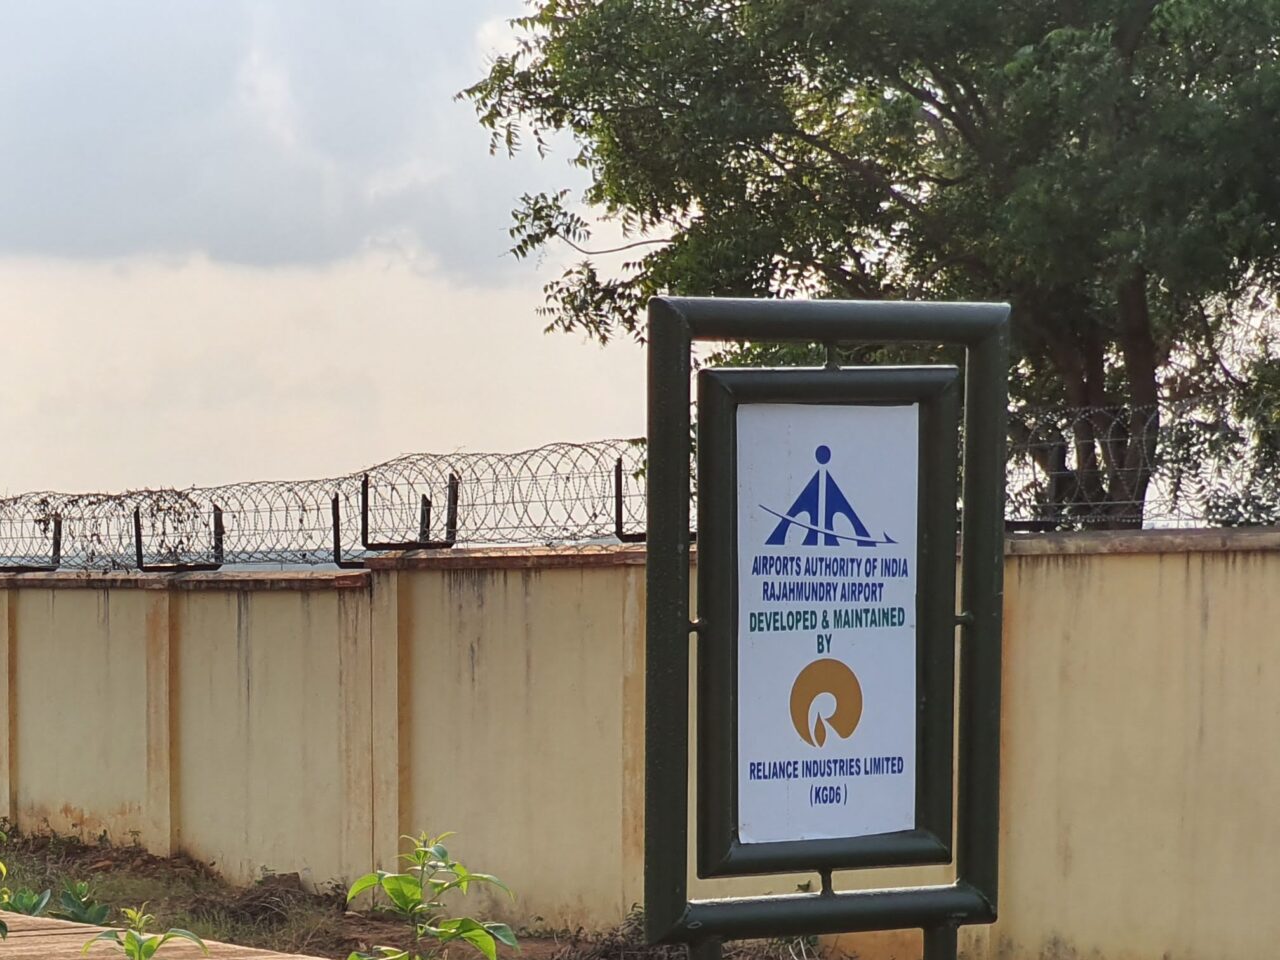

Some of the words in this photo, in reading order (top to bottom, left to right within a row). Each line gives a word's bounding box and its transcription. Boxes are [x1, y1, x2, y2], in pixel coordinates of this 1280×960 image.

[752, 555, 801, 577] AIRPORTS
[804, 556, 862, 577] AUTHORITY
[864, 557, 878, 577] OF
[881, 557, 908, 577] INDIA
[762, 581, 838, 602] RAJAHMUNDRY
[840, 582, 884, 602] AIRPORT
[750, 610, 817, 632] DEVELOPED
[821, 609, 830, 629] &
[833, 607, 905, 629] MAINTAINED
[817, 634, 832, 654] BY
[749, 761, 799, 780] RELIANCE
[802, 758, 861, 779] INDUSTRIES
[863, 756, 904, 775] LIMITED
